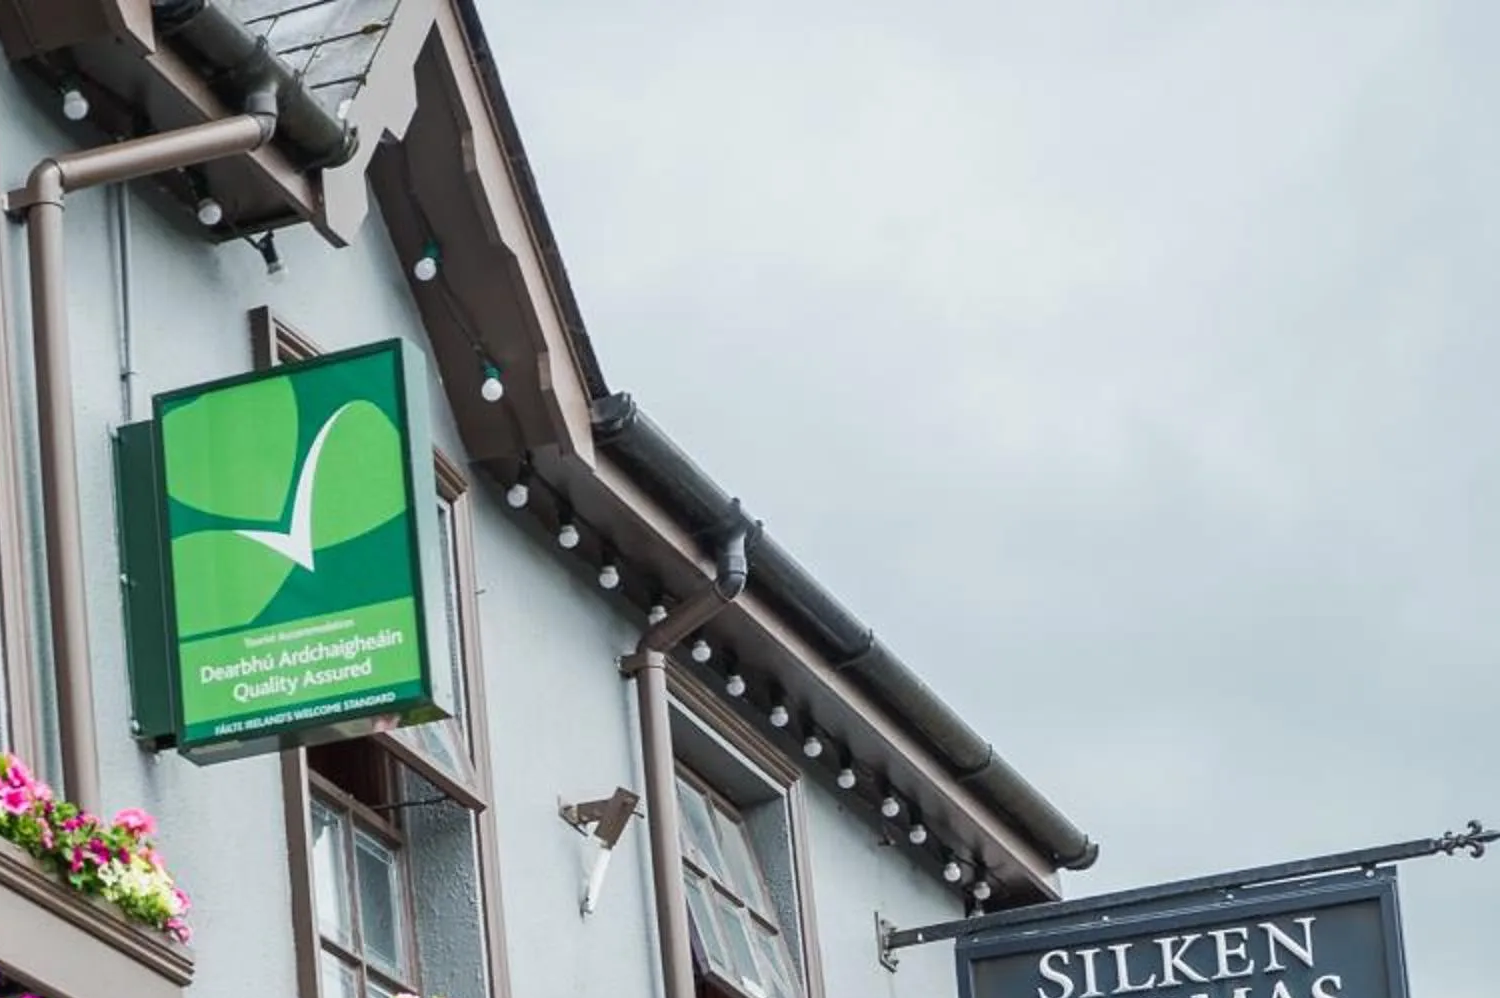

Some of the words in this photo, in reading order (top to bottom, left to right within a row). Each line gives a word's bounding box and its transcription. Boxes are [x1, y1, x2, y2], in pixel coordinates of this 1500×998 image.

[201, 653, 275, 684] Dearbhú
[279, 629, 403, 668] Ardchaigheáin
[233, 673, 298, 702] Quality
[303, 658, 372, 688] Assured
[294, 704, 342, 721] WELCOME
[344, 691, 396, 710] STANDARD
